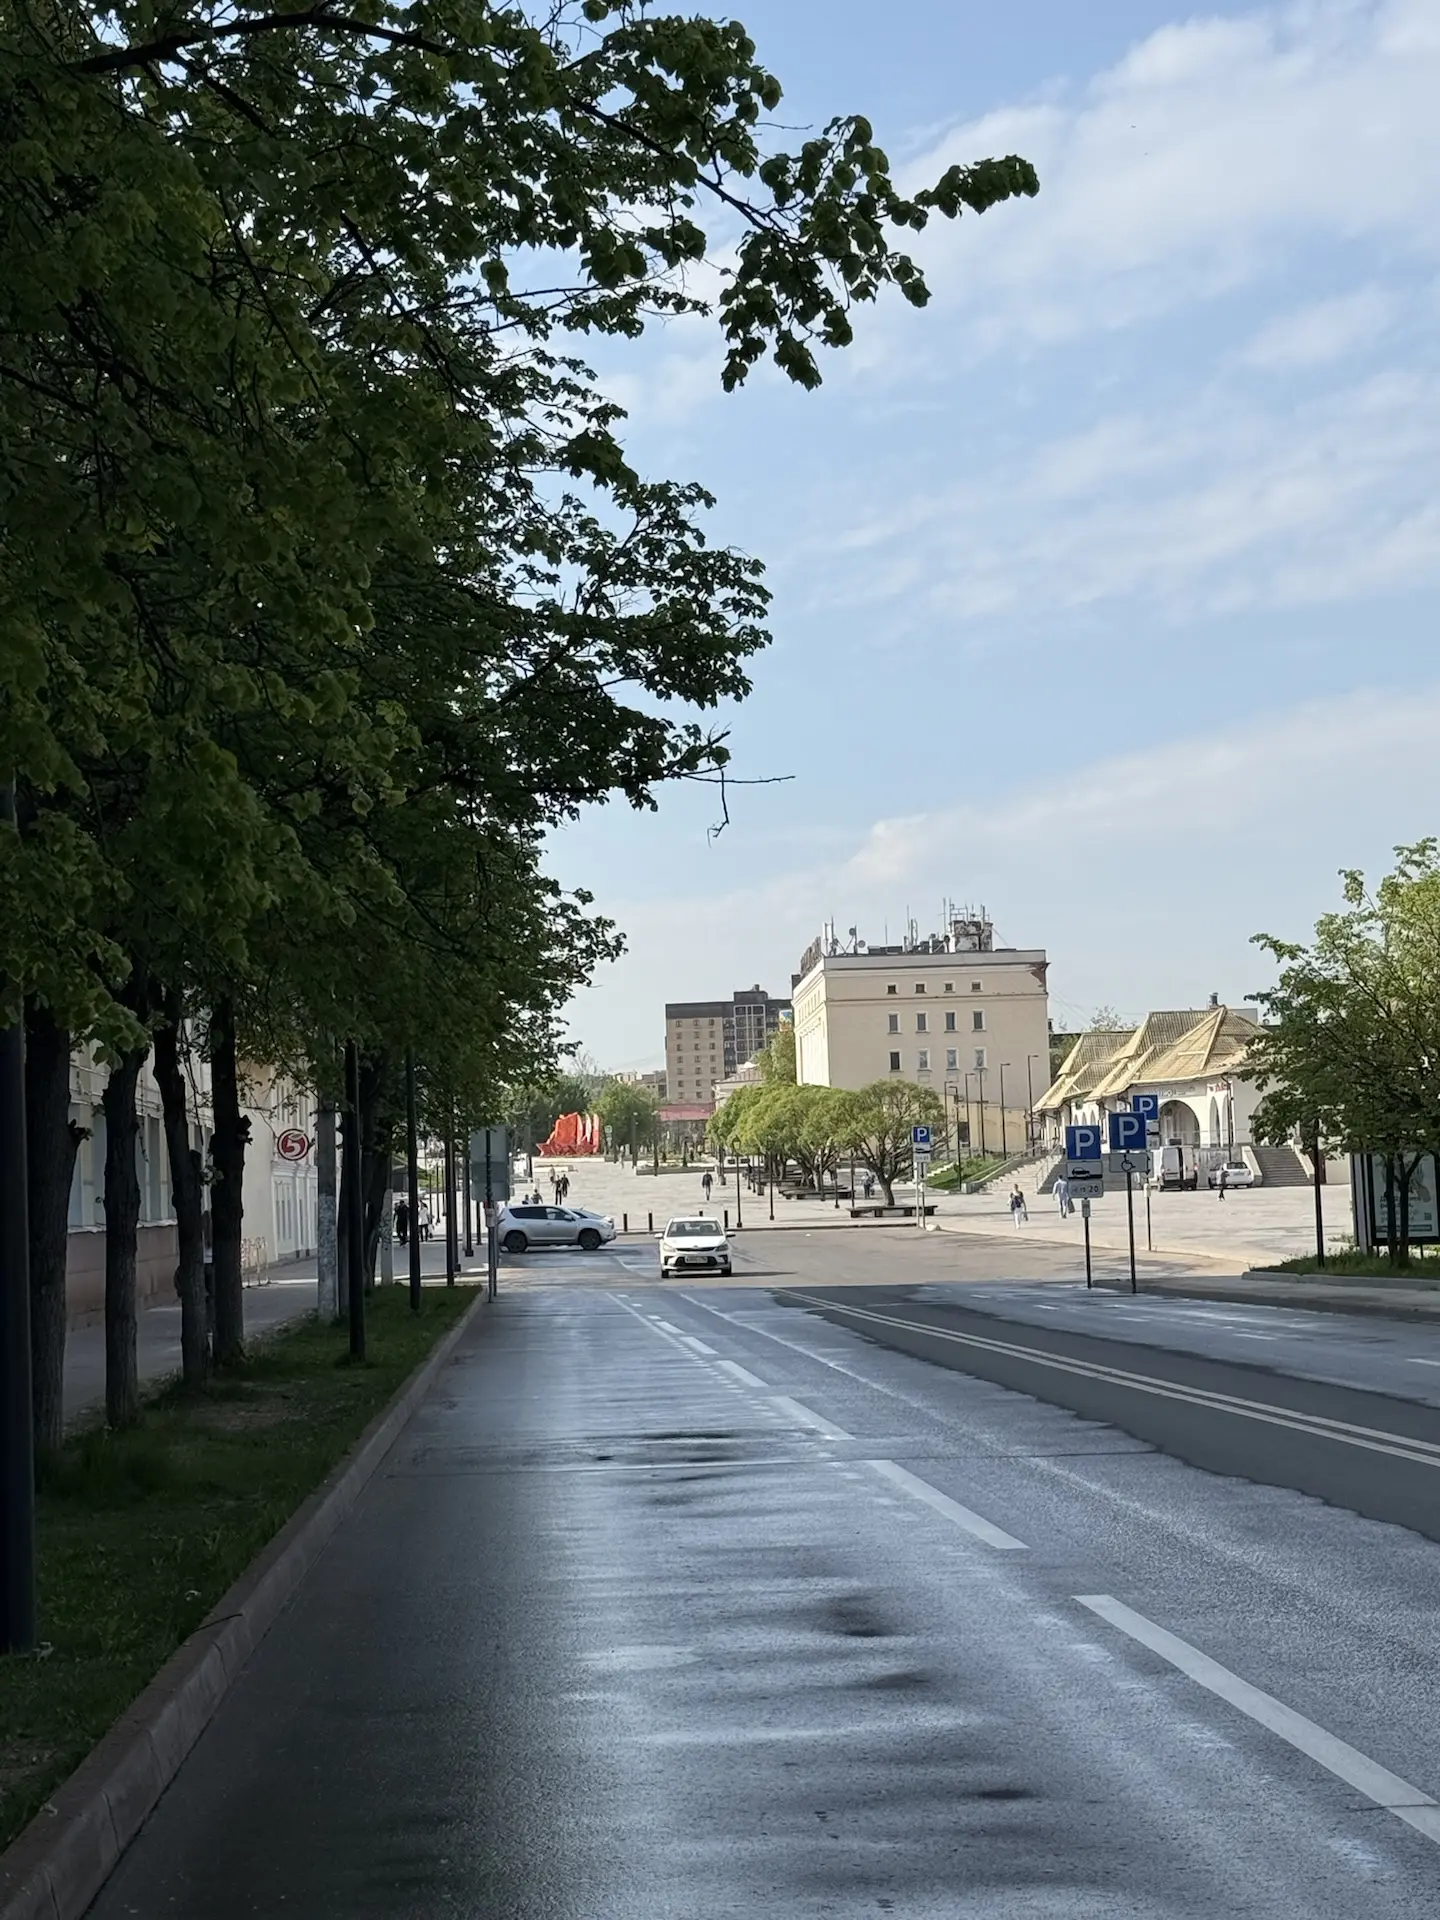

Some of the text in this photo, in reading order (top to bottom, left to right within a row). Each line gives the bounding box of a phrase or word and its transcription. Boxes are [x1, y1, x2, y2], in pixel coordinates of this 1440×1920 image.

[1139, 1097, 1154, 1112] P
[917, 1127, 928, 1142] P
[1118, 1117, 1140, 1146] P
[1075, 1129, 1095, 1157] P
[1088, 1185, 1099, 1193] 20
